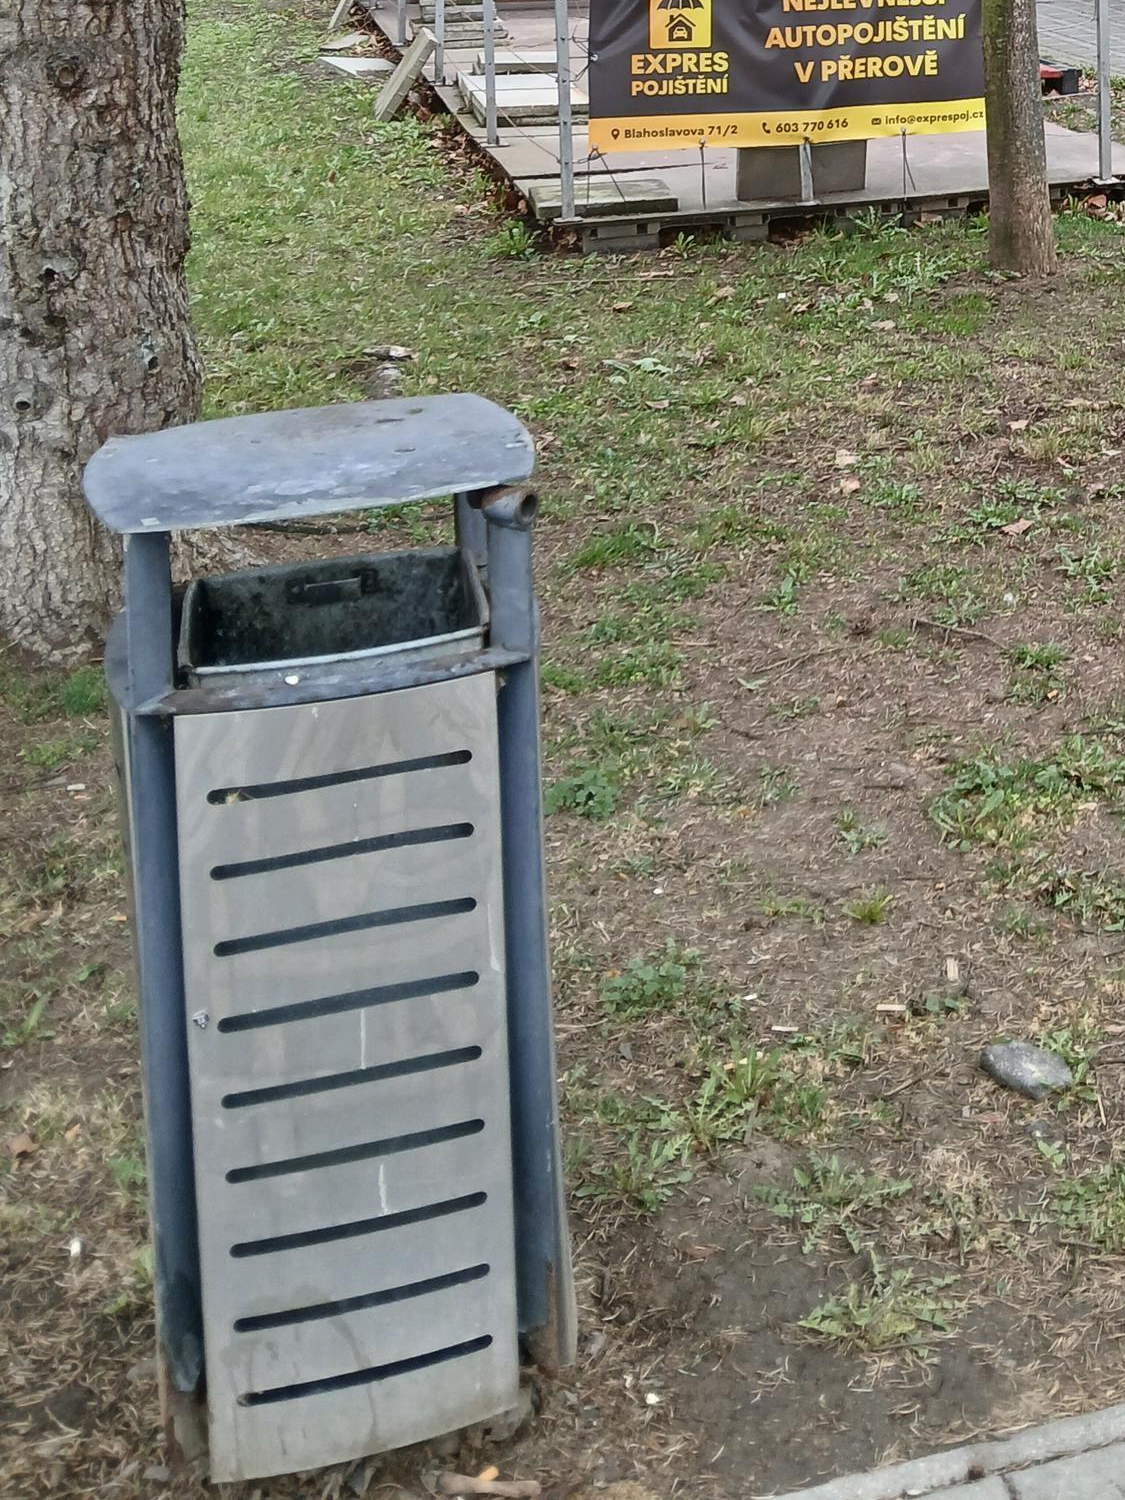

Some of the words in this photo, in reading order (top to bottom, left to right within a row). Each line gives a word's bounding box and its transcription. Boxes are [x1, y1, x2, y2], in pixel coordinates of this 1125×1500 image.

[764, 14, 967, 49] AUTOPOJIŠTĚNÍ
[630, 52, 729, 76] EXPRES
[793, 61, 812, 84] V
[821, 49, 939, 82] PŘEROVĚ
[630, 73, 729, 97] POJIŠTĚNÍ
[775, 122, 799, 133] 603
[802, 120, 824, 132] 770
[827, 118, 849, 129] 616
[885, 109, 985, 126] info@exprespoj.cz
[624, 127, 705, 139] Blahoslavova
[708, 124, 738, 137] 71/2
